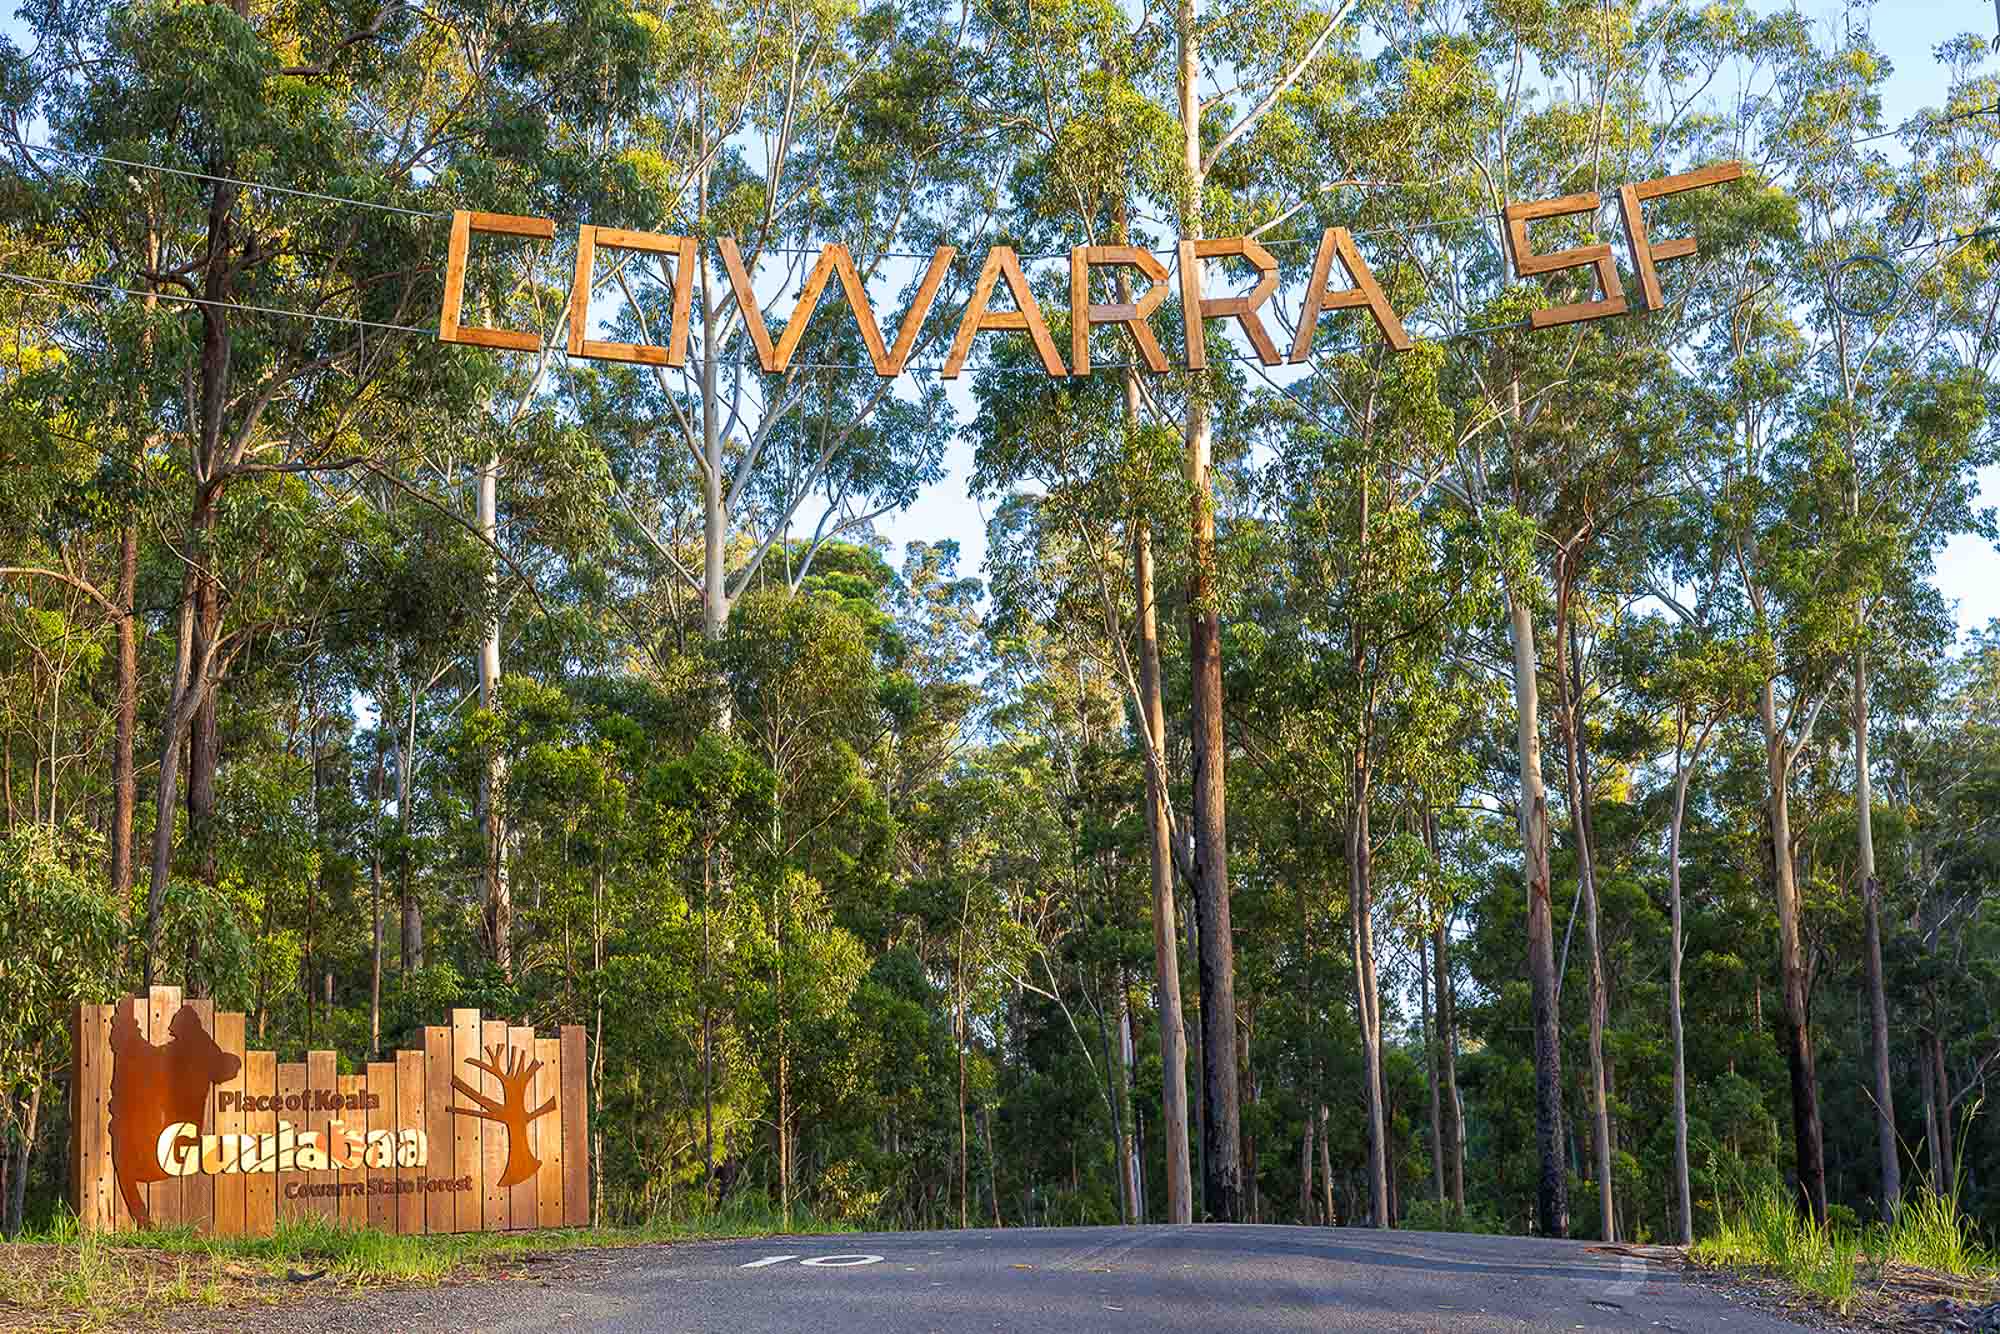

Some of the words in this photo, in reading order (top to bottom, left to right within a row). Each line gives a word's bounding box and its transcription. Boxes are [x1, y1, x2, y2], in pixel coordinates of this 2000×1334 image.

[439, 208, 1413, 381] COWARRA
[1504, 160, 1743, 330] SF
[218, 1090, 283, 1113] Place
[285, 1089, 311, 1112] of
[314, 1088, 380, 1112] Koala
[156, 1119, 428, 1177] Guulabaa
[285, 1181, 365, 1200] Cowarra
[367, 1176, 415, 1195] State
[417, 1174, 473, 1194] Forest
